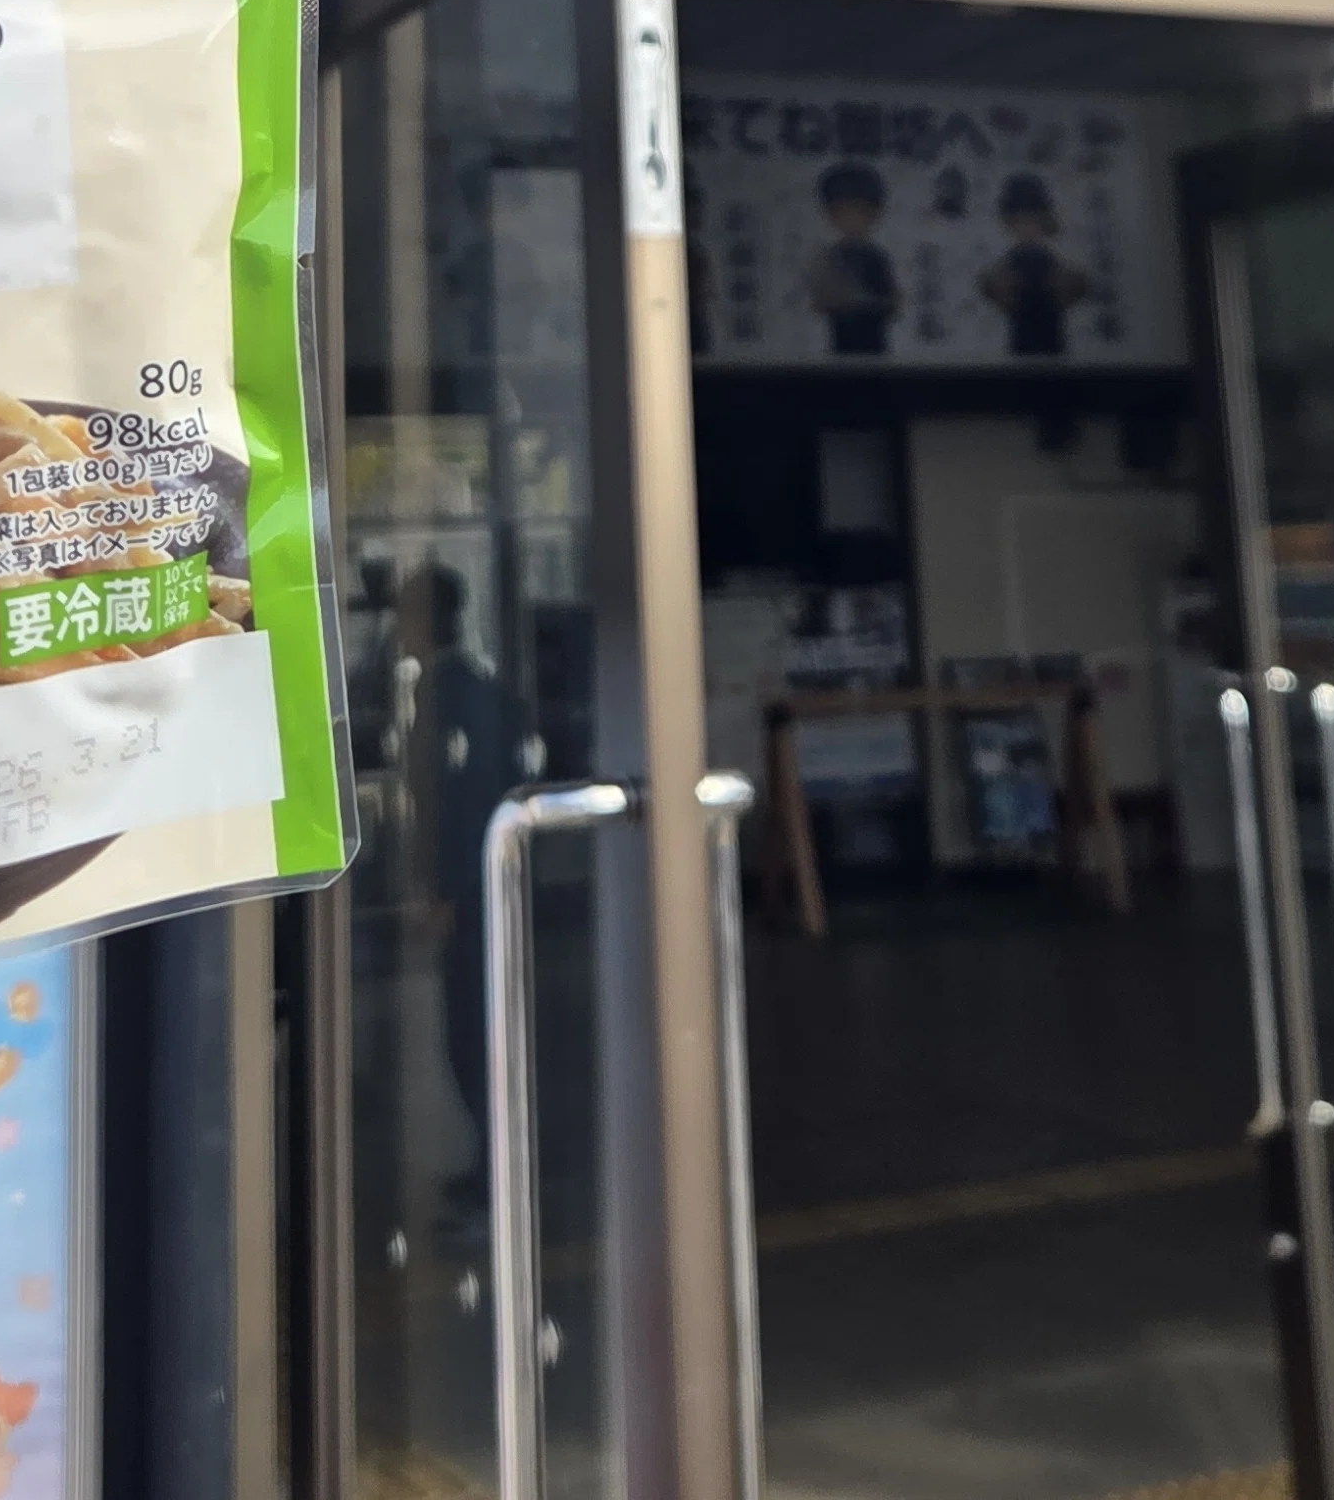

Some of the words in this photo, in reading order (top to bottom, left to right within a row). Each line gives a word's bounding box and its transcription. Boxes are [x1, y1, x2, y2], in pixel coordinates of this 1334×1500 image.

[140, 360, 203, 398] 80g
[88, 407, 208, 450] 98kcal
[6, 448, 213, 494] 1包装(80g)当たり
[5, 577, 153, 658] 要冷蔵
